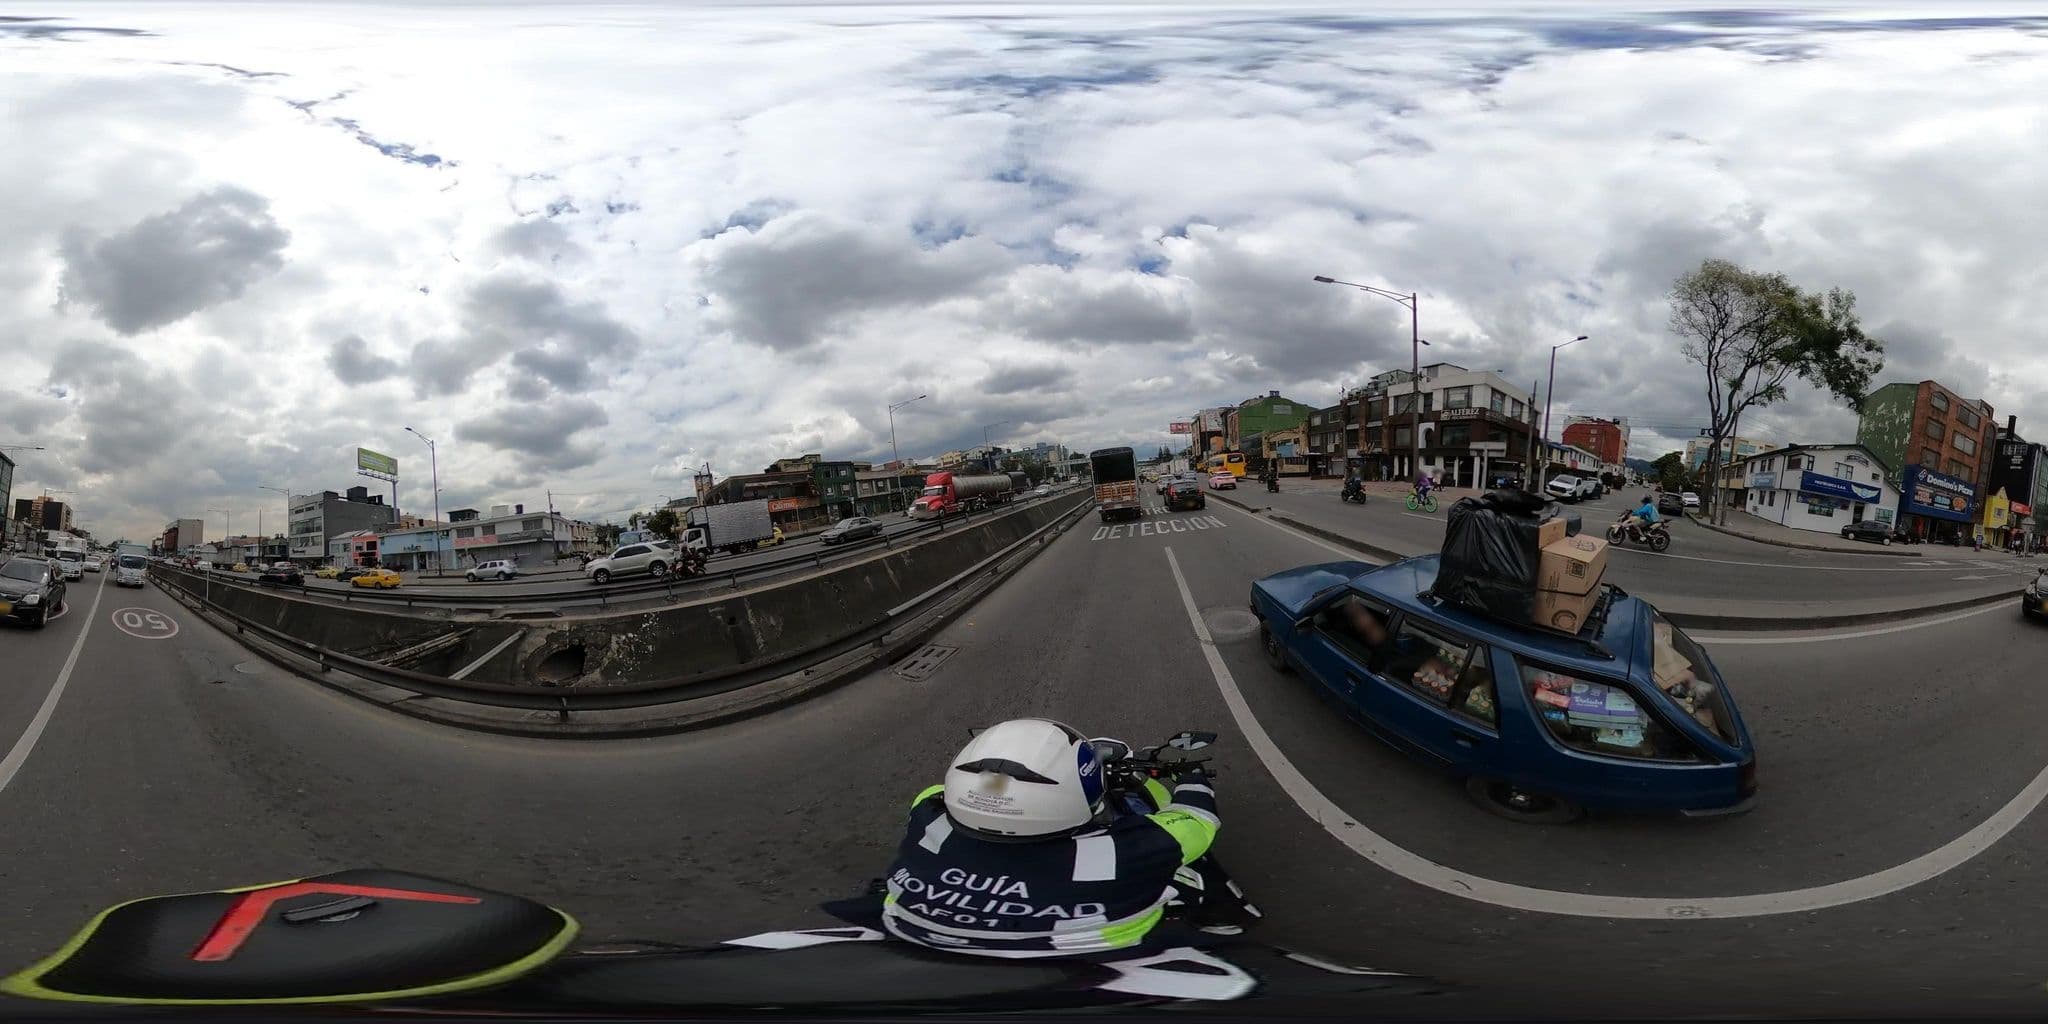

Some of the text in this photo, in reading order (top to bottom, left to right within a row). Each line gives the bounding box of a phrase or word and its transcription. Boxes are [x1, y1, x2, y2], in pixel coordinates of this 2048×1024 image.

[1927, 474, 1958, 491] Domino's
[123, 612, 168, 630] 50
[893, 867, 1106, 919] MOVILIDAD
[940, 867, 1030, 899] GUÍA
